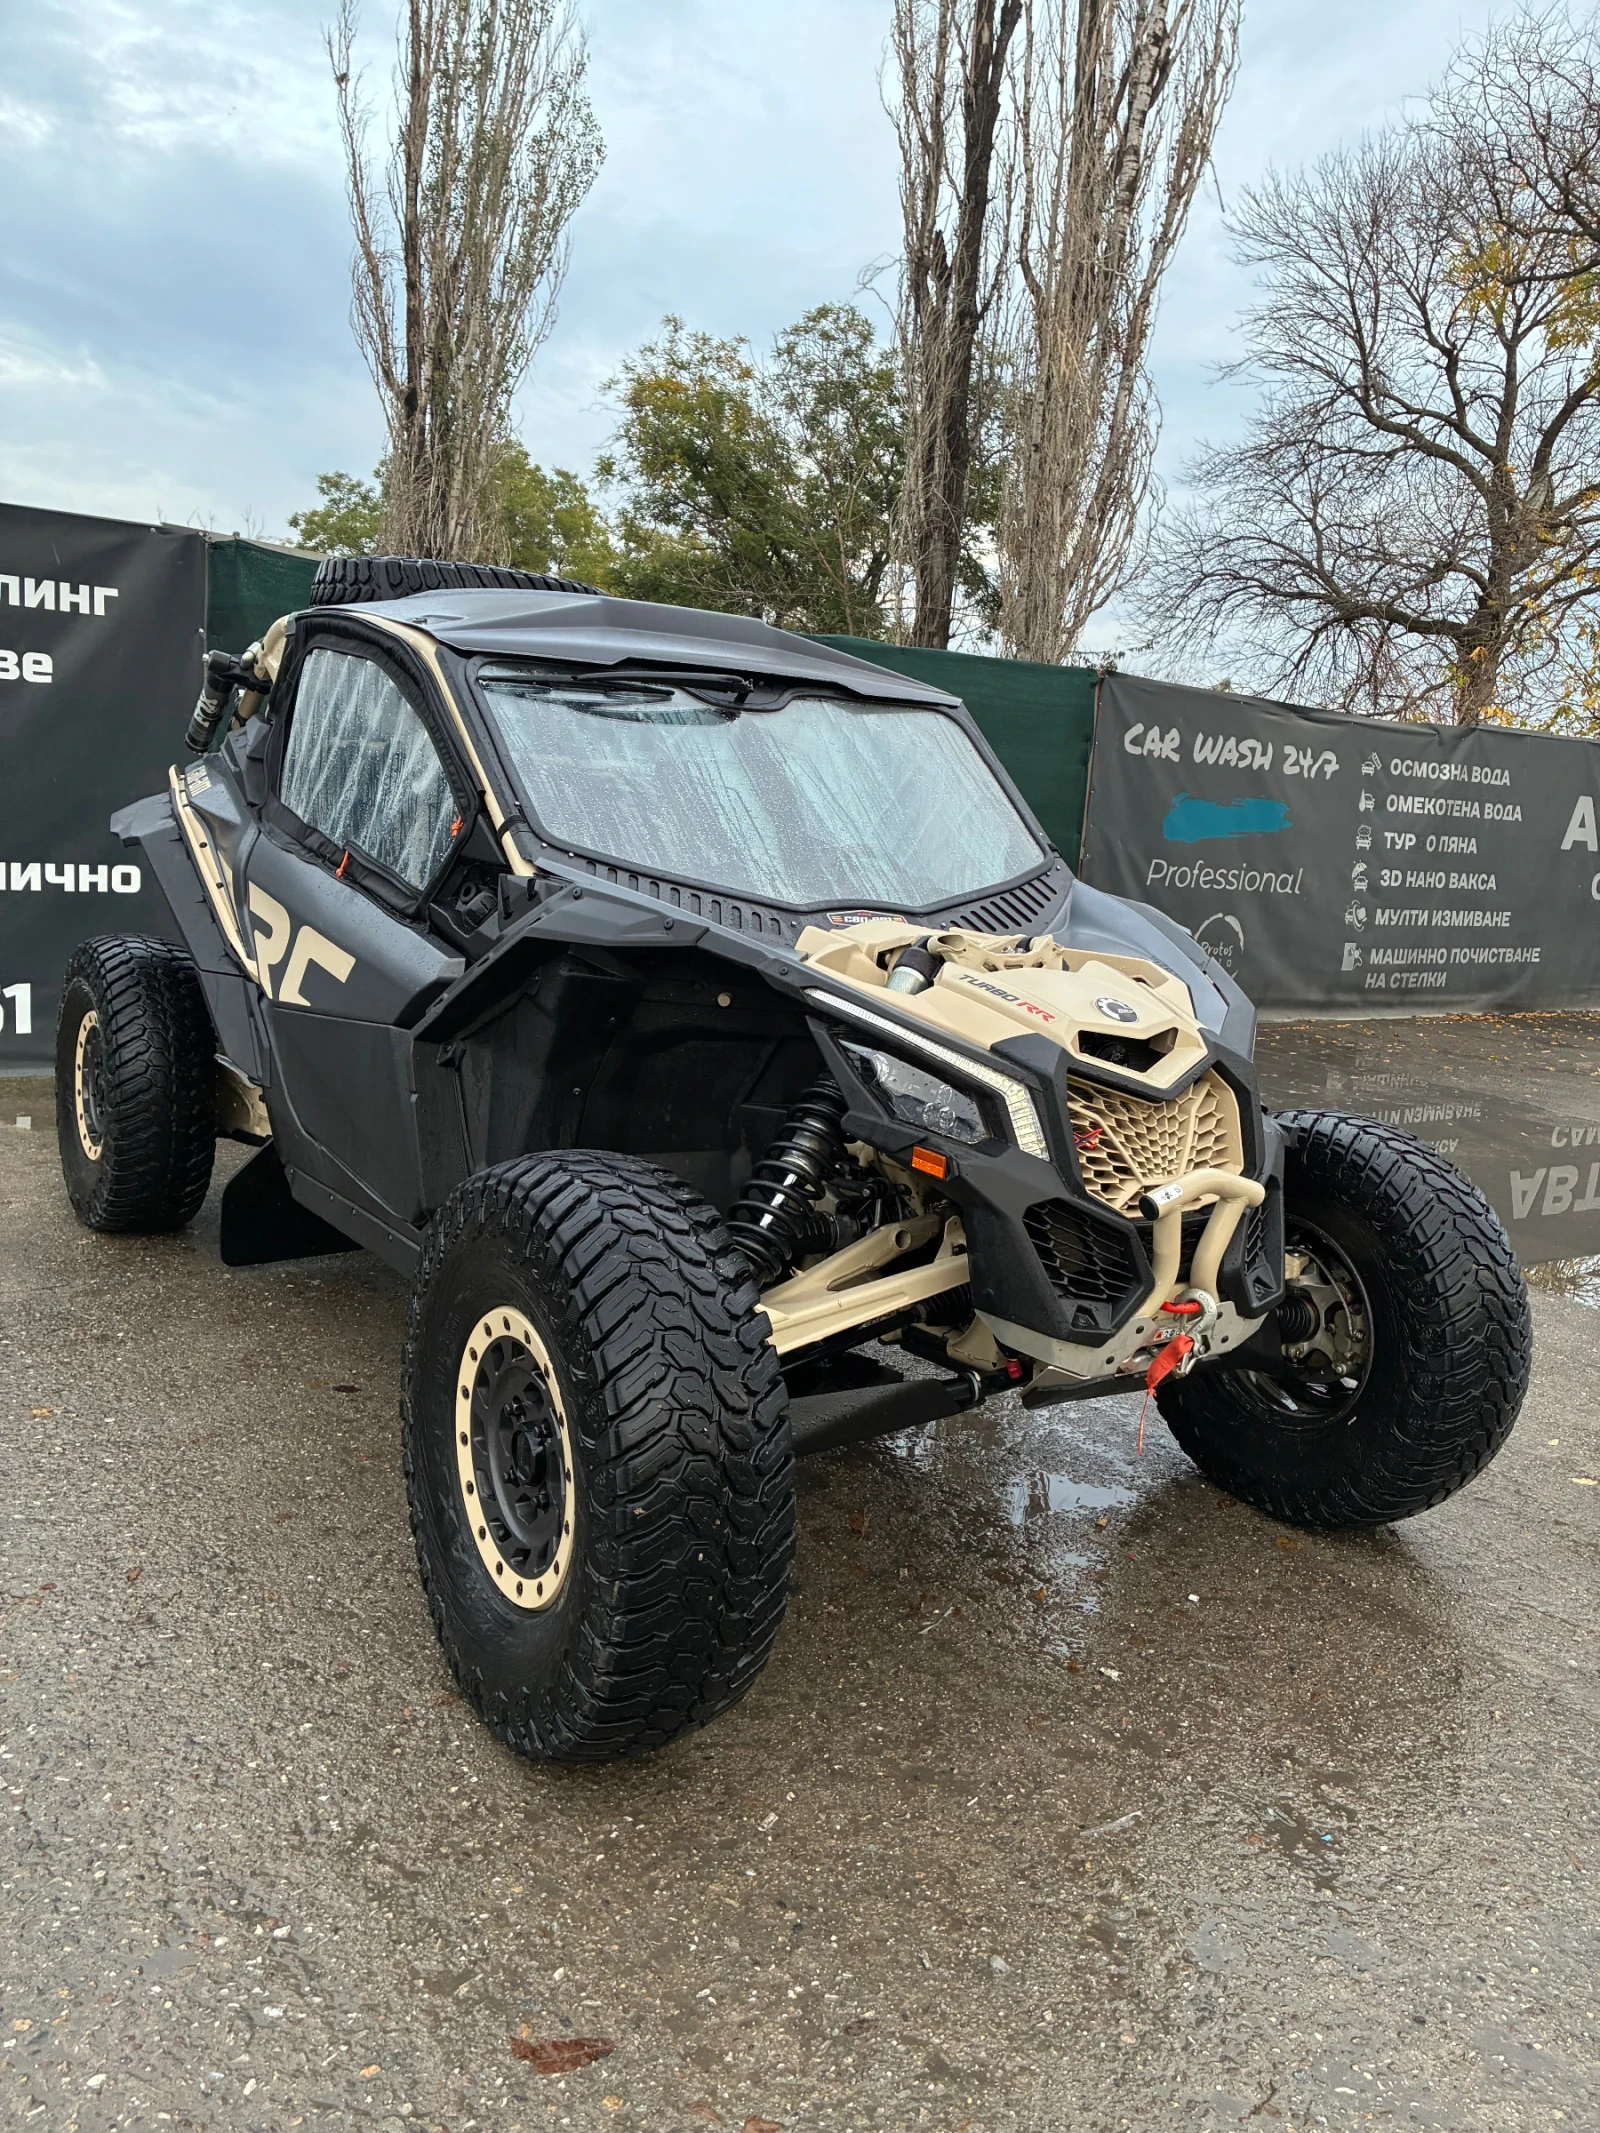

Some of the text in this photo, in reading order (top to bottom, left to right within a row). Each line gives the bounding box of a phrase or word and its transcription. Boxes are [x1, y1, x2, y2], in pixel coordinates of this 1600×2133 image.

[1124, 722, 1181, 763] CAR
[1193, 732, 1273, 771] WASH
[1389, 758, 1511, 786] ОСМОЗНА ВОДА
[1386, 794, 1522, 822] ОМЕКОТЕНА ВОДА
[1438, 835, 1477, 854] ПЯНА
[0, 861, 141, 893] ично
[1146, 858, 1304, 894] Professional
[1380, 868, 1497, 891] 3D НАНО ВАКСА
[1375, 908, 1511, 928] МУЛТИ ИЗМИВАНЕ
[1369, 947, 1541, 965] МАШИННО ПОЧИСТВАНЕ
[1364, 971, 1447, 989] НА СТЕЛКИ
[959, 974, 1056, 1023] TURBO RR
